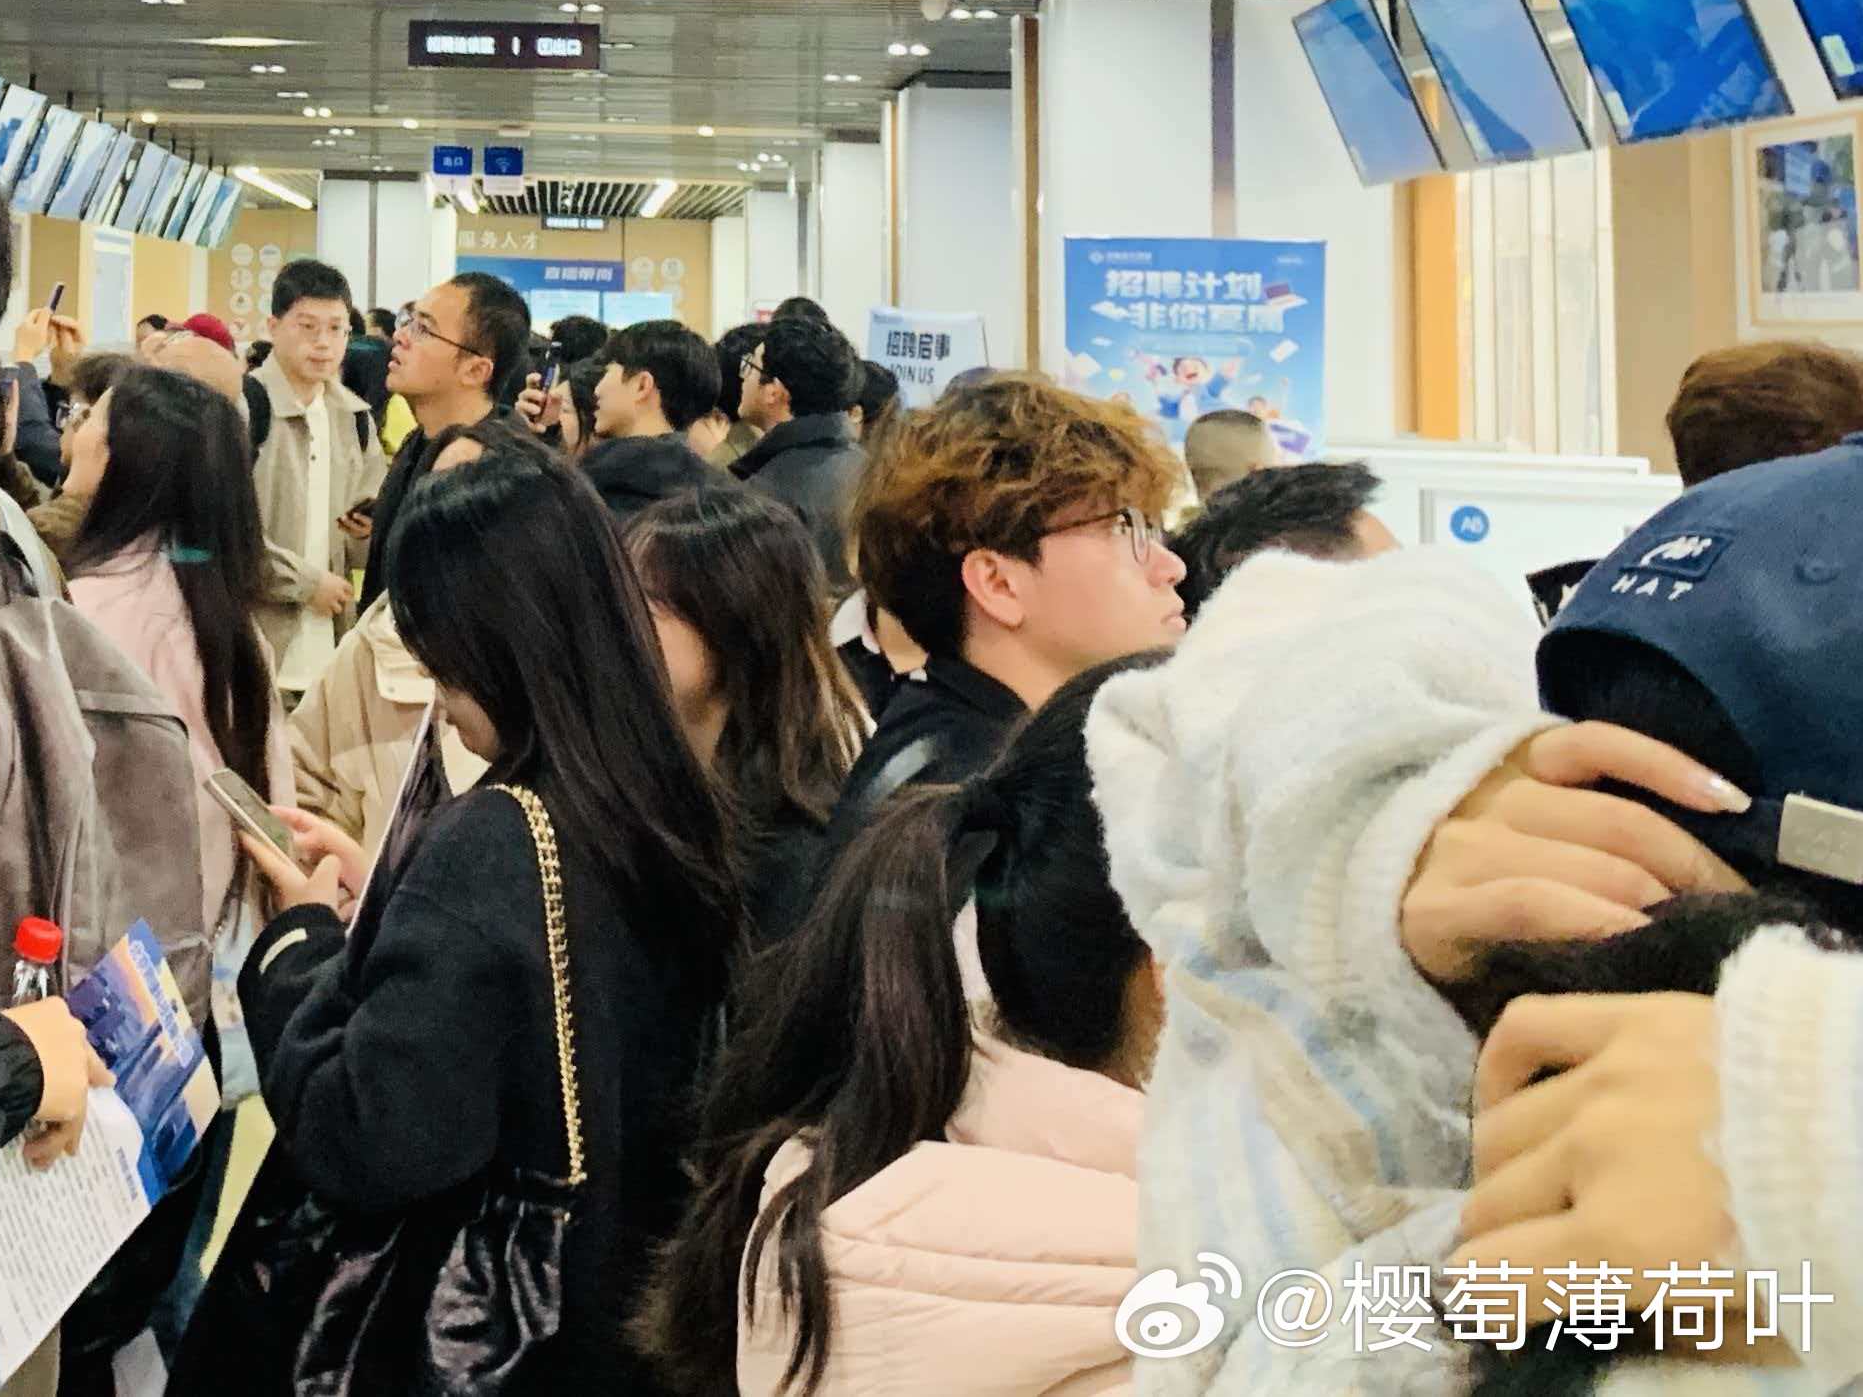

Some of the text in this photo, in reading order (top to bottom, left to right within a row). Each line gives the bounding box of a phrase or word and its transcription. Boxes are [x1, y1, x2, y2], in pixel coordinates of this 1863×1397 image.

[442, 156, 464, 167] 出口
[458, 230, 538, 250] 服务人才
[1105, 269, 1263, 301] 招聘计划
[886, 330, 951, 360] 招聘启事
[918, 366, 936, 384] US
